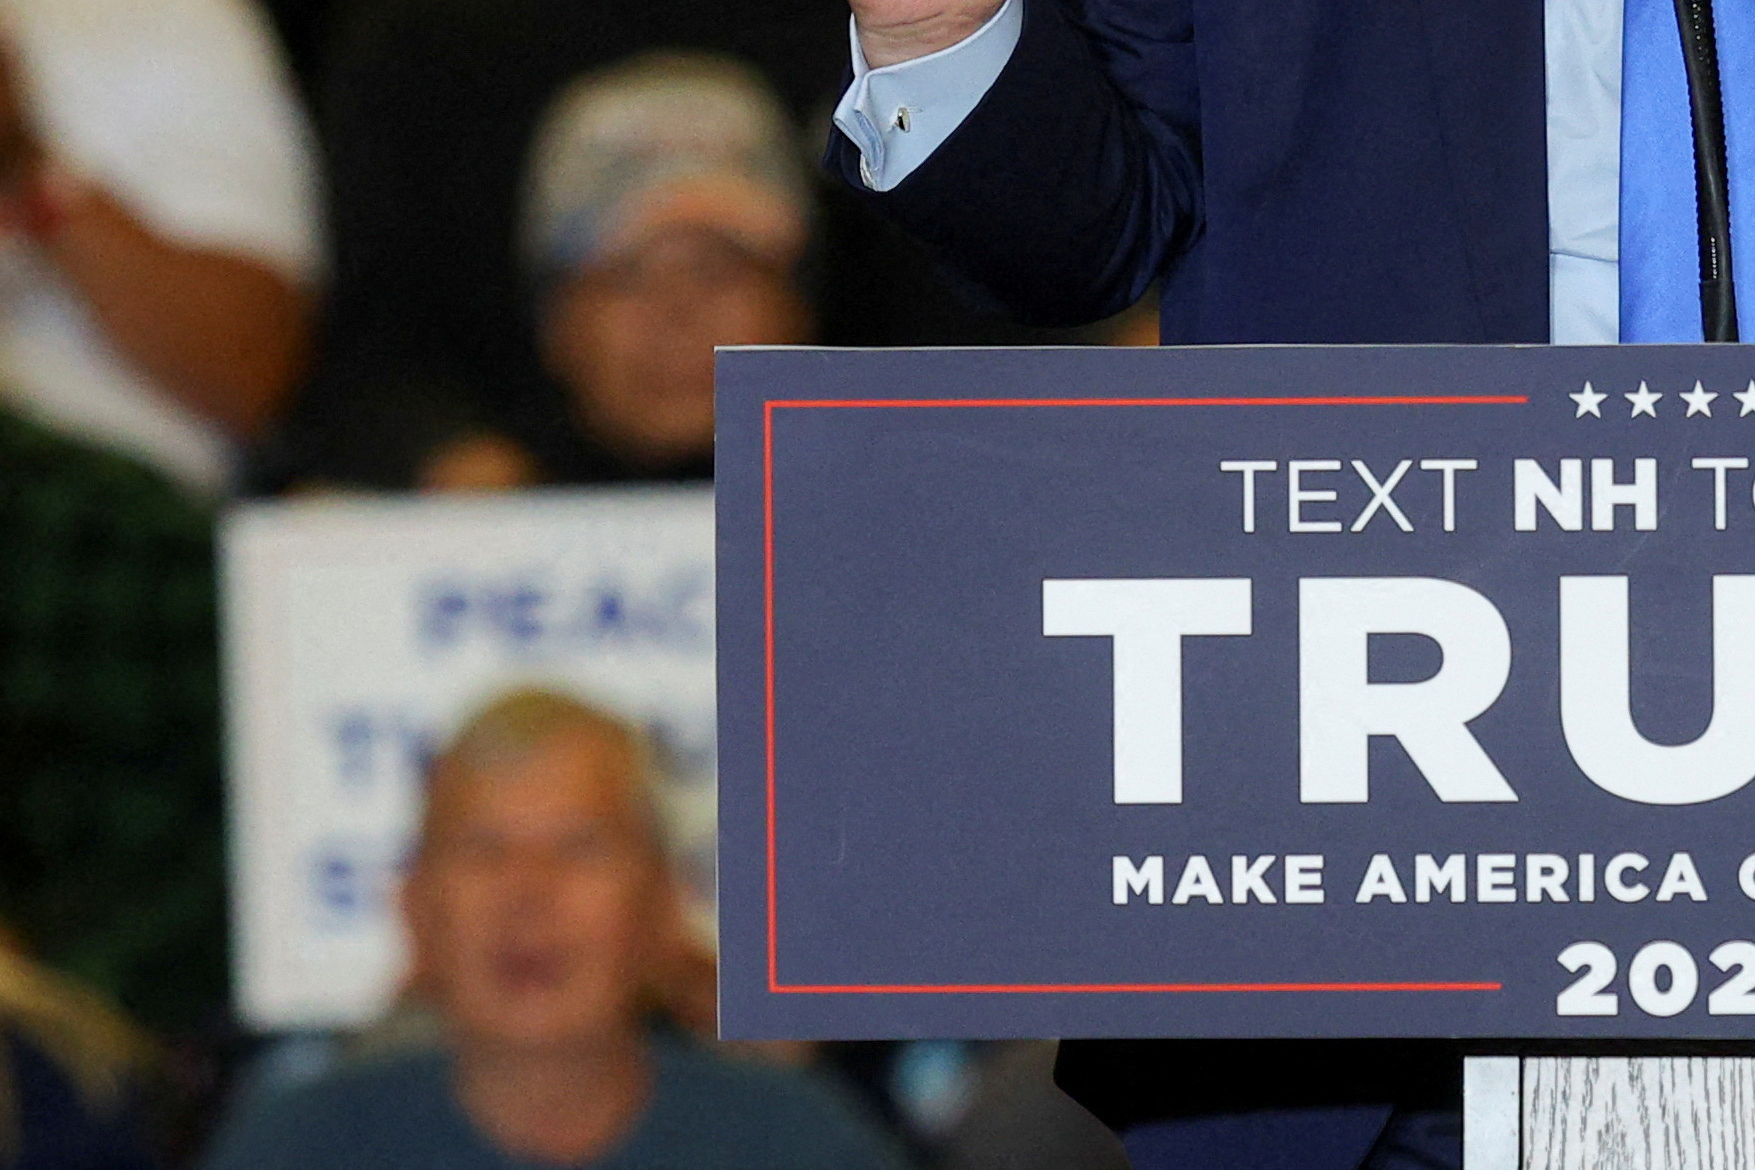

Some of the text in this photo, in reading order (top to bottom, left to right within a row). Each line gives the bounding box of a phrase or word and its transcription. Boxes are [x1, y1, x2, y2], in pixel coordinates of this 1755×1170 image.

[1220, 458, 1477, 533] TEXT
[1513, 457, 1658, 532] NH
[1112, 855, 1325, 905] MAKE
[1355, 853, 1708, 903] AMERICA
